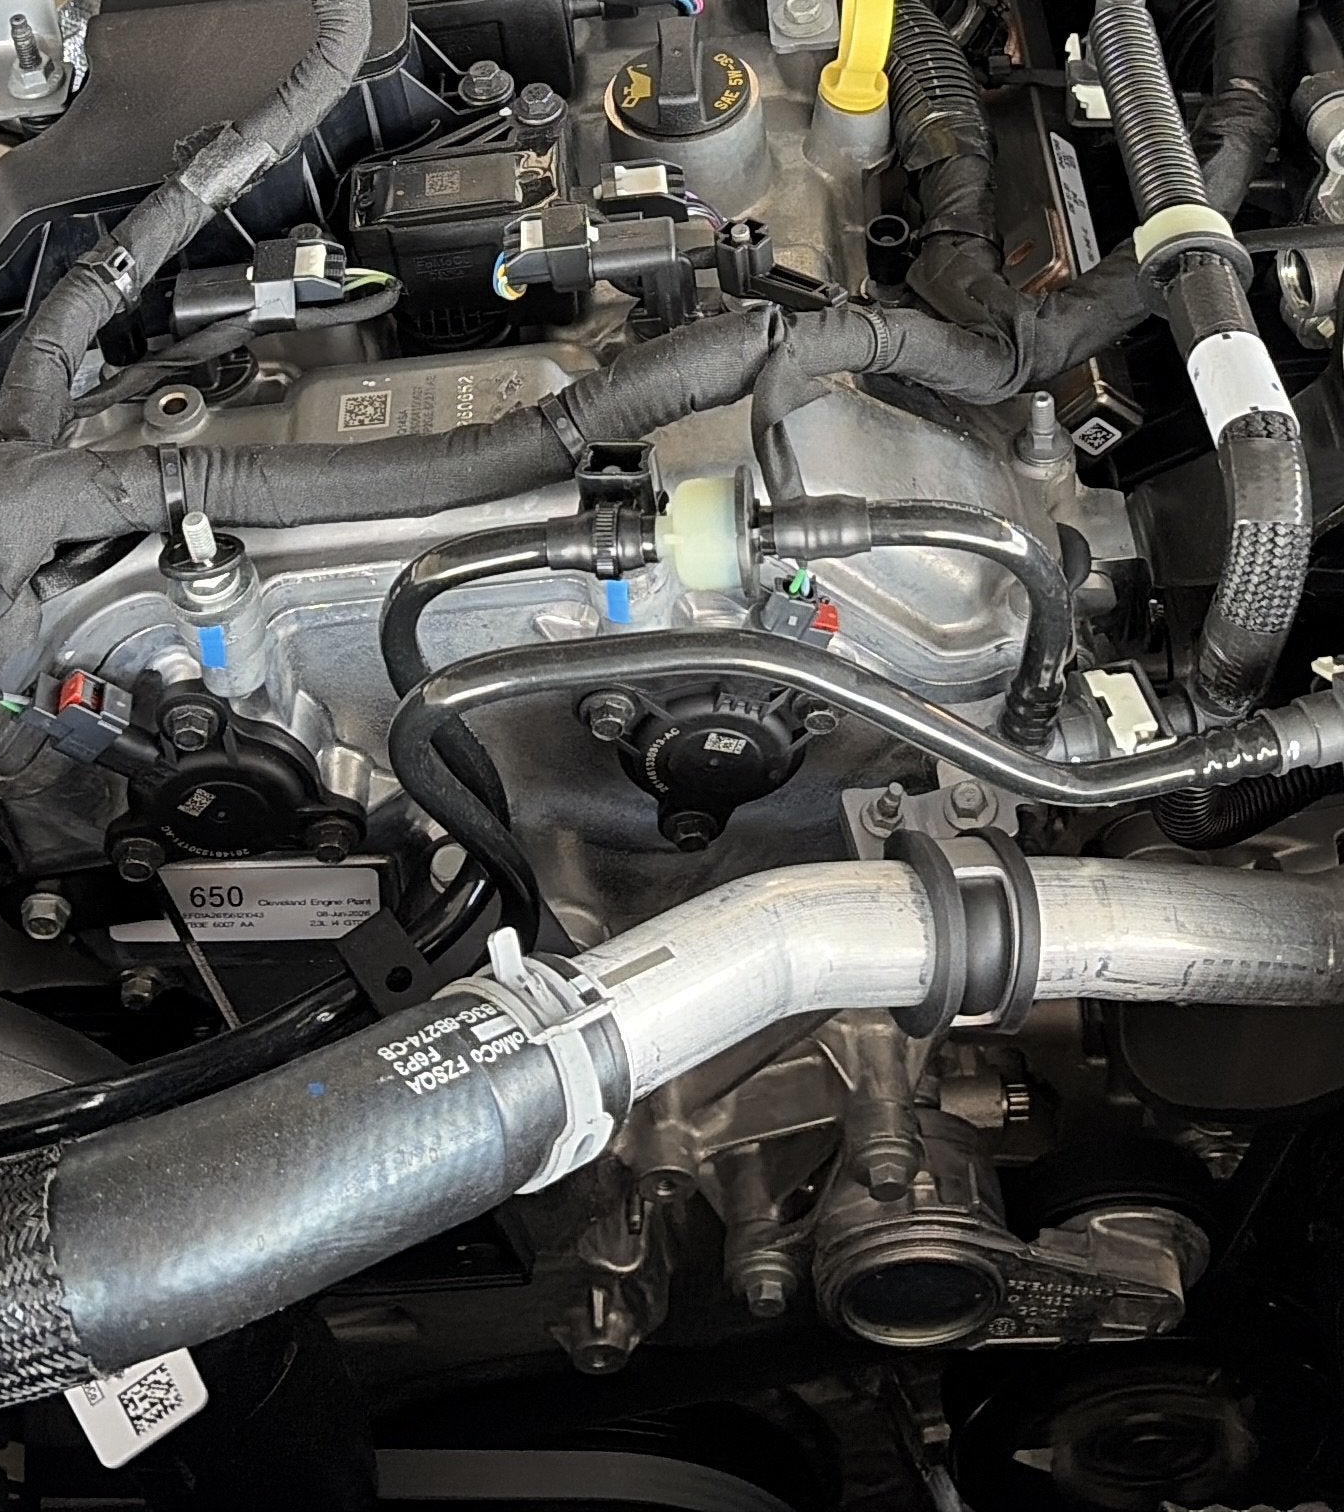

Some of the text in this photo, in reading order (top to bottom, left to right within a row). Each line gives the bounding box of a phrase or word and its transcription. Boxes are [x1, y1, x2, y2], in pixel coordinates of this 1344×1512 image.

[713, 52, 744, 111] SAE 5W-30
[189, 885, 244, 908] 650
[257, 897, 372, 908] Cleveland Engine Plant
[240, 920, 255, 928] AA
[392, 1045, 442, 1076] F6P3
[405, 1031, 525, 1095] oMoCo FZSQA
